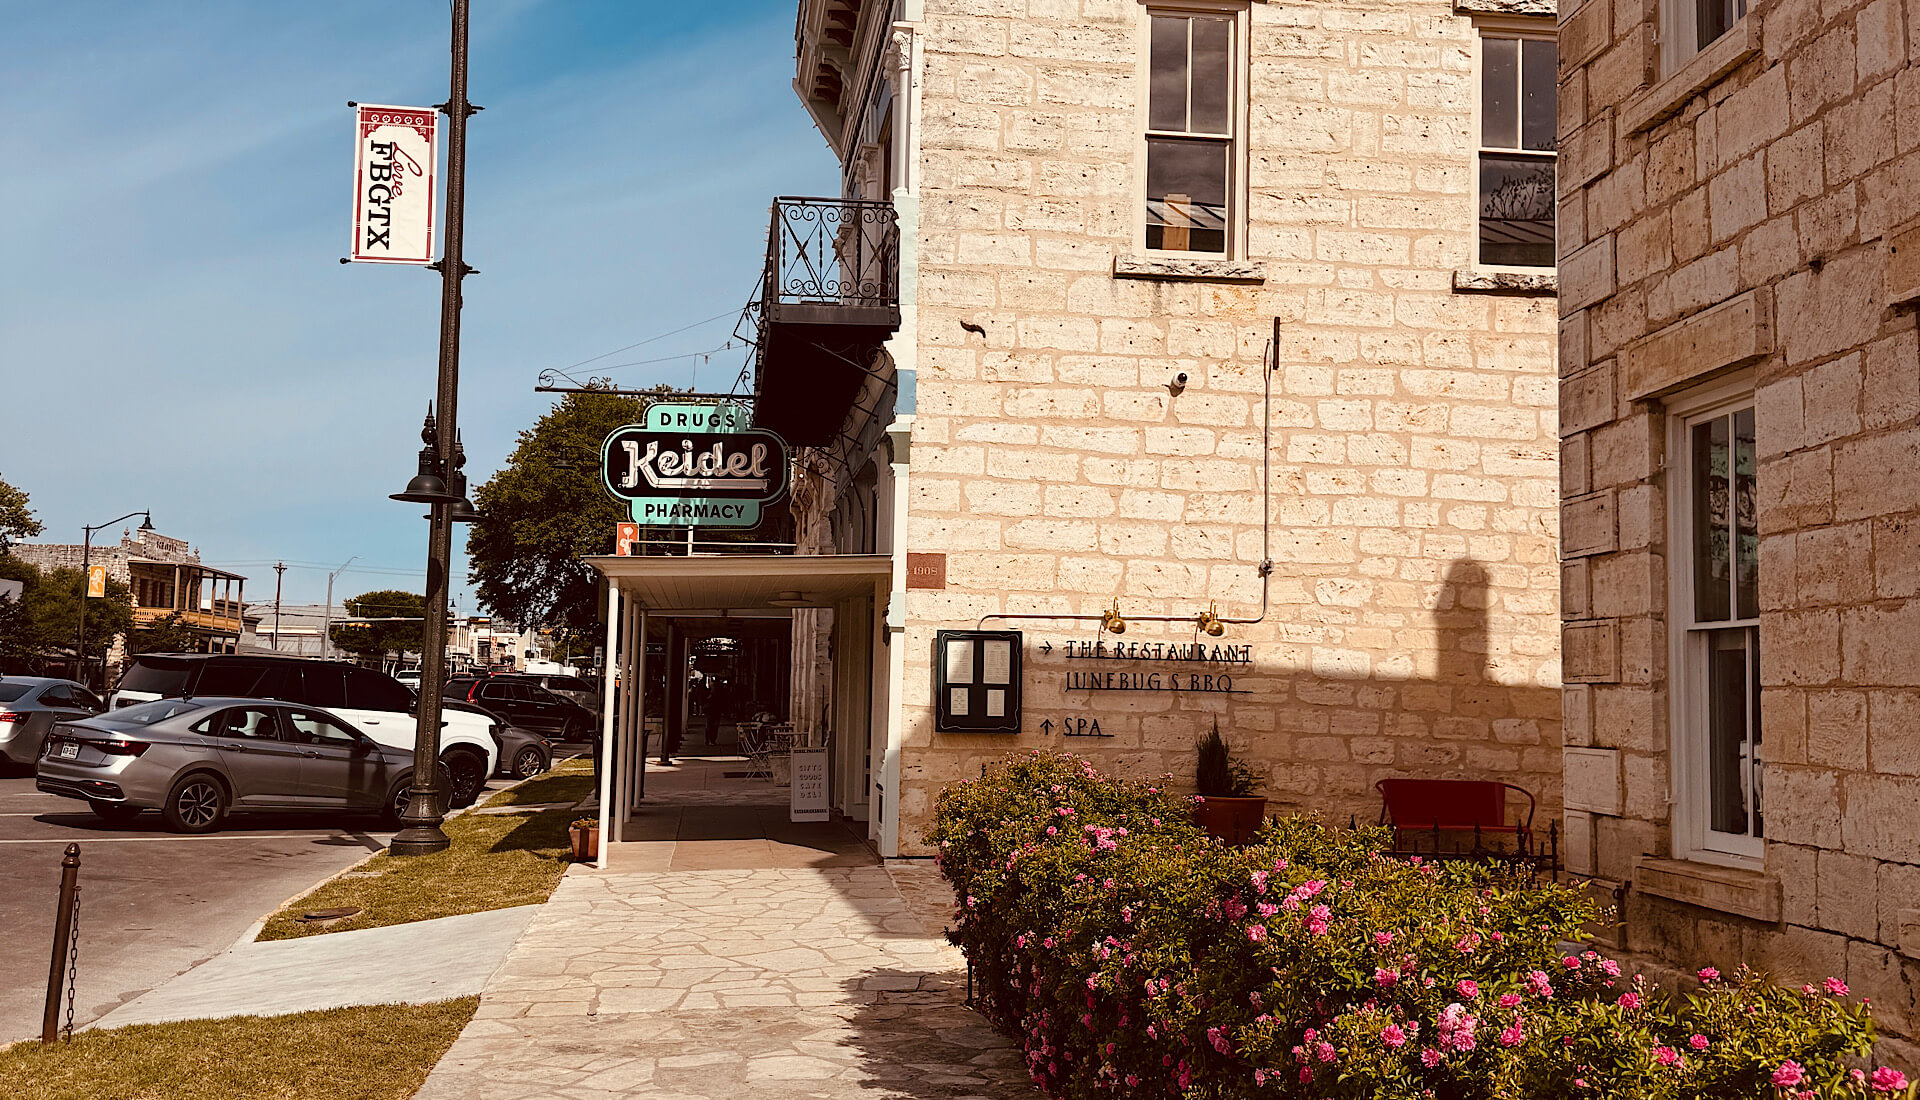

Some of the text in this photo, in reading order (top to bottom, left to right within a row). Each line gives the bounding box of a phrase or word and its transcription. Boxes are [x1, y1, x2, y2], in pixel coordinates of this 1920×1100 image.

[391, 141, 423, 200] Love
[366, 139, 393, 251] FBGTX
[660, 412, 736, 428] DRUGS
[619, 439, 772, 490] Keidel
[644, 503, 746, 519] PHARMACY
[1065, 640, 1253, 662] THE RESTAURANT
[1065, 671, 1161, 692] JUNEBUG
[1190, 674, 1233, 693] BBQ
[1063, 717, 1103, 736] SPA
